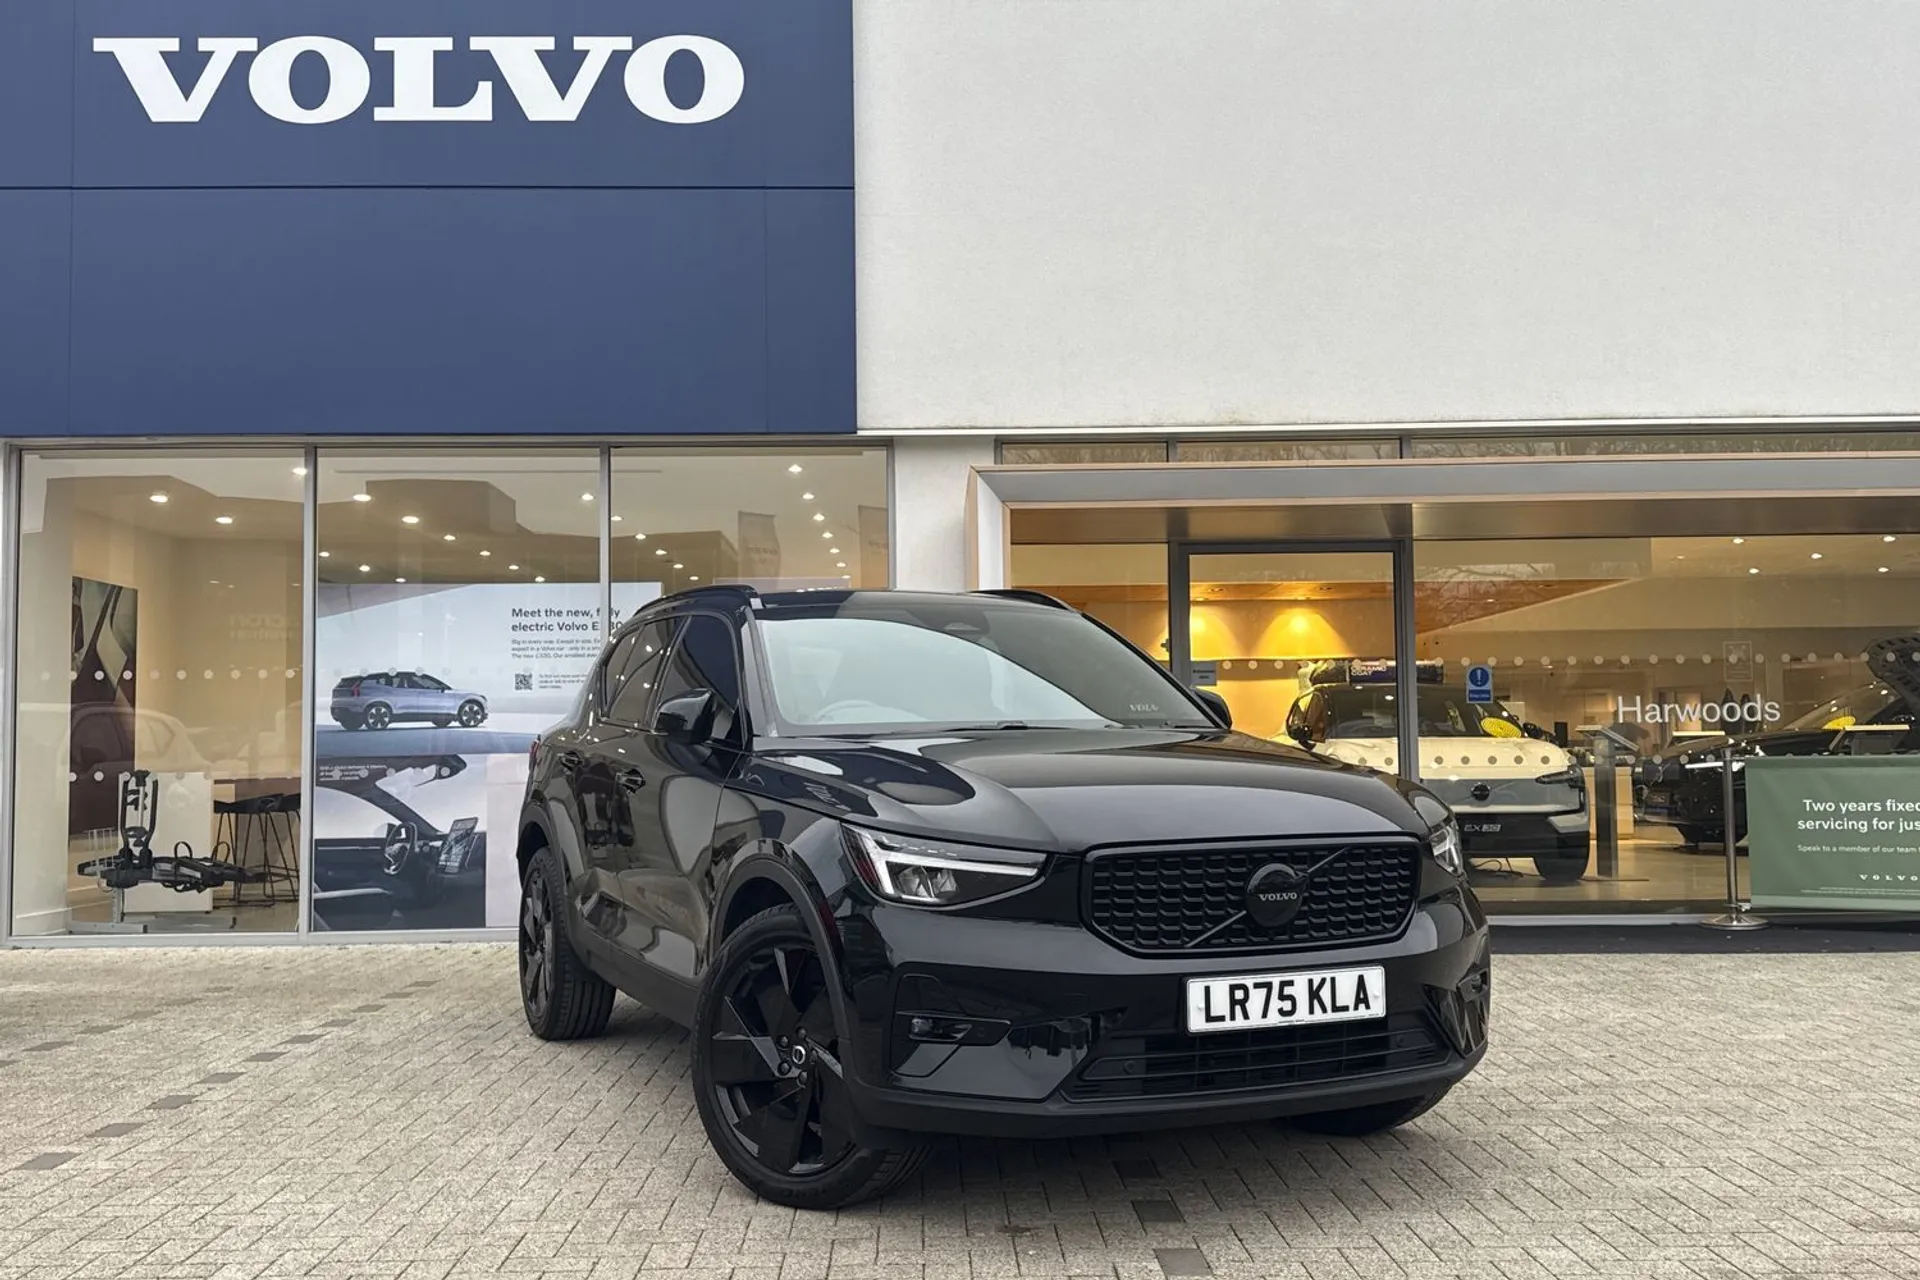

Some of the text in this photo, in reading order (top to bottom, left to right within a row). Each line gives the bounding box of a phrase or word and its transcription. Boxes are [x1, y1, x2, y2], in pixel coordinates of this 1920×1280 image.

[93, 35, 745, 124] VOLVO
[511, 607, 620, 618] Meet the new, fly
[511, 622, 554, 632] electric
[557, 621, 588, 632] Volvo
[1617, 693, 1781, 724] Harwoods
[1802, 799, 1836, 812] Two
[1839, 801, 1882, 814] years
[1797, 817, 1868, 833] servicing
[1872, 817, 1895, 831] for
[1257, 892, 1297, 901] VOLVO
[1204, 974, 1371, 1023] LR75 KLA
